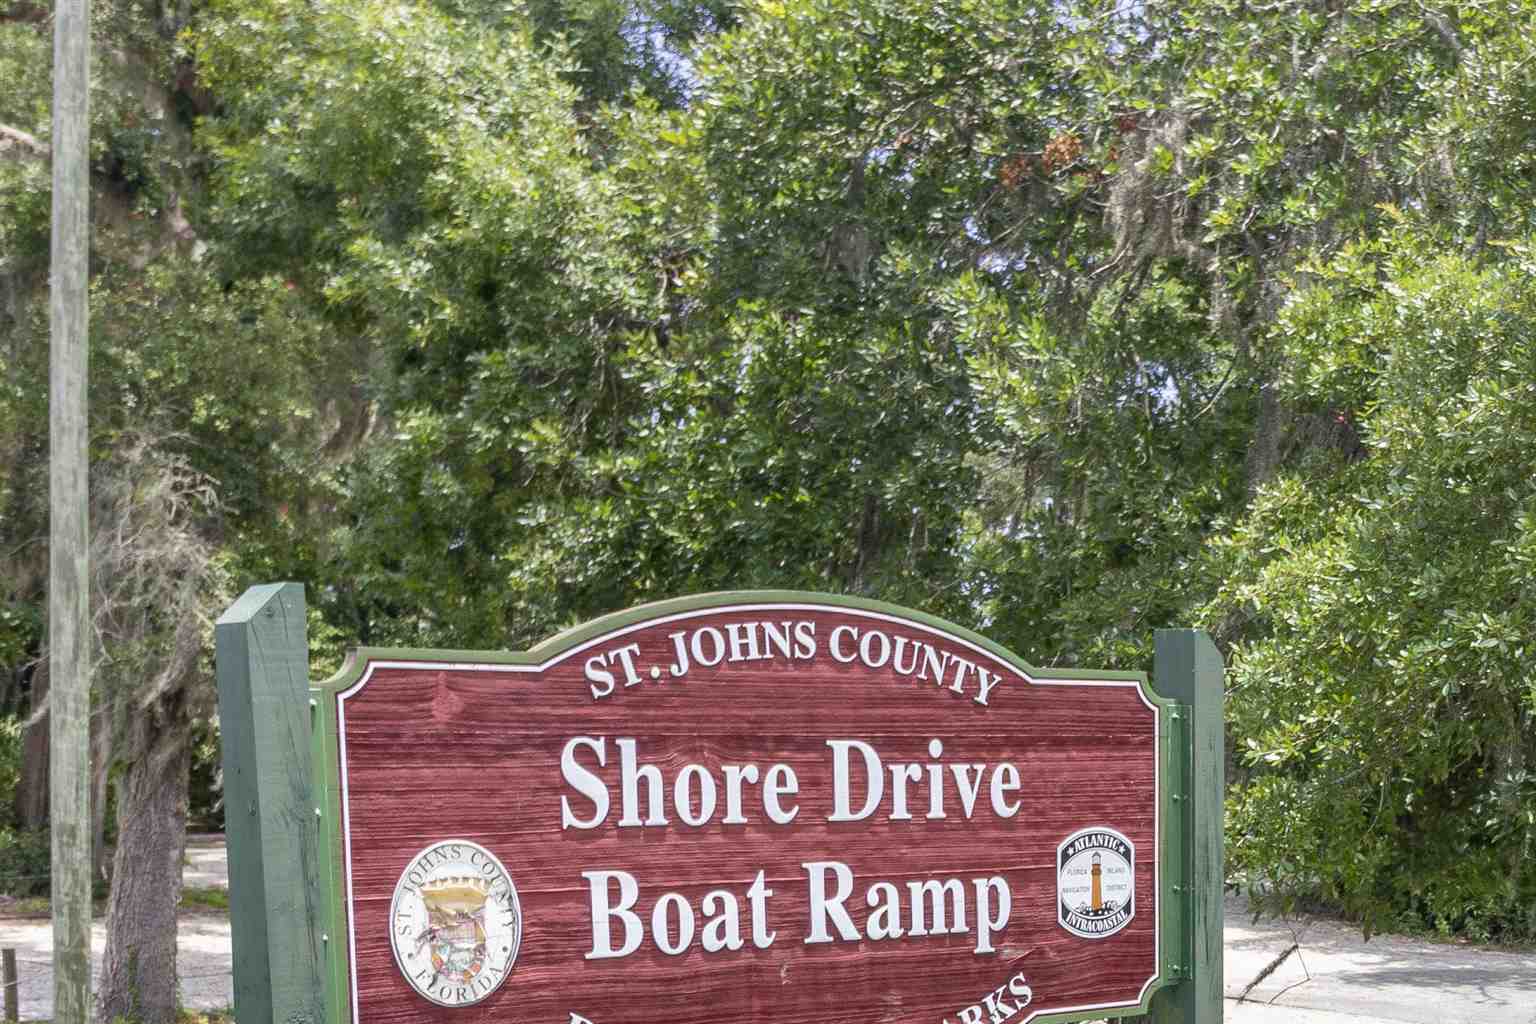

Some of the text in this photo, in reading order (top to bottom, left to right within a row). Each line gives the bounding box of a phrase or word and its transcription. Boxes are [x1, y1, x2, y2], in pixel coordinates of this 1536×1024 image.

[585, 621, 1001, 705] ST. JOHNS COUNTY
[560, 736, 1022, 830] Shore Drive
[1074, 834, 1120, 852] ATLANTIC
[403, 845, 461, 896] JOHNS
[471, 851, 514, 927] COUNTY
[581, 861, 1011, 959] Boat Ramp
[1066, 911, 1128, 932] INTRACOASTAL
[415, 966, 503, 1000] FLORIDA
